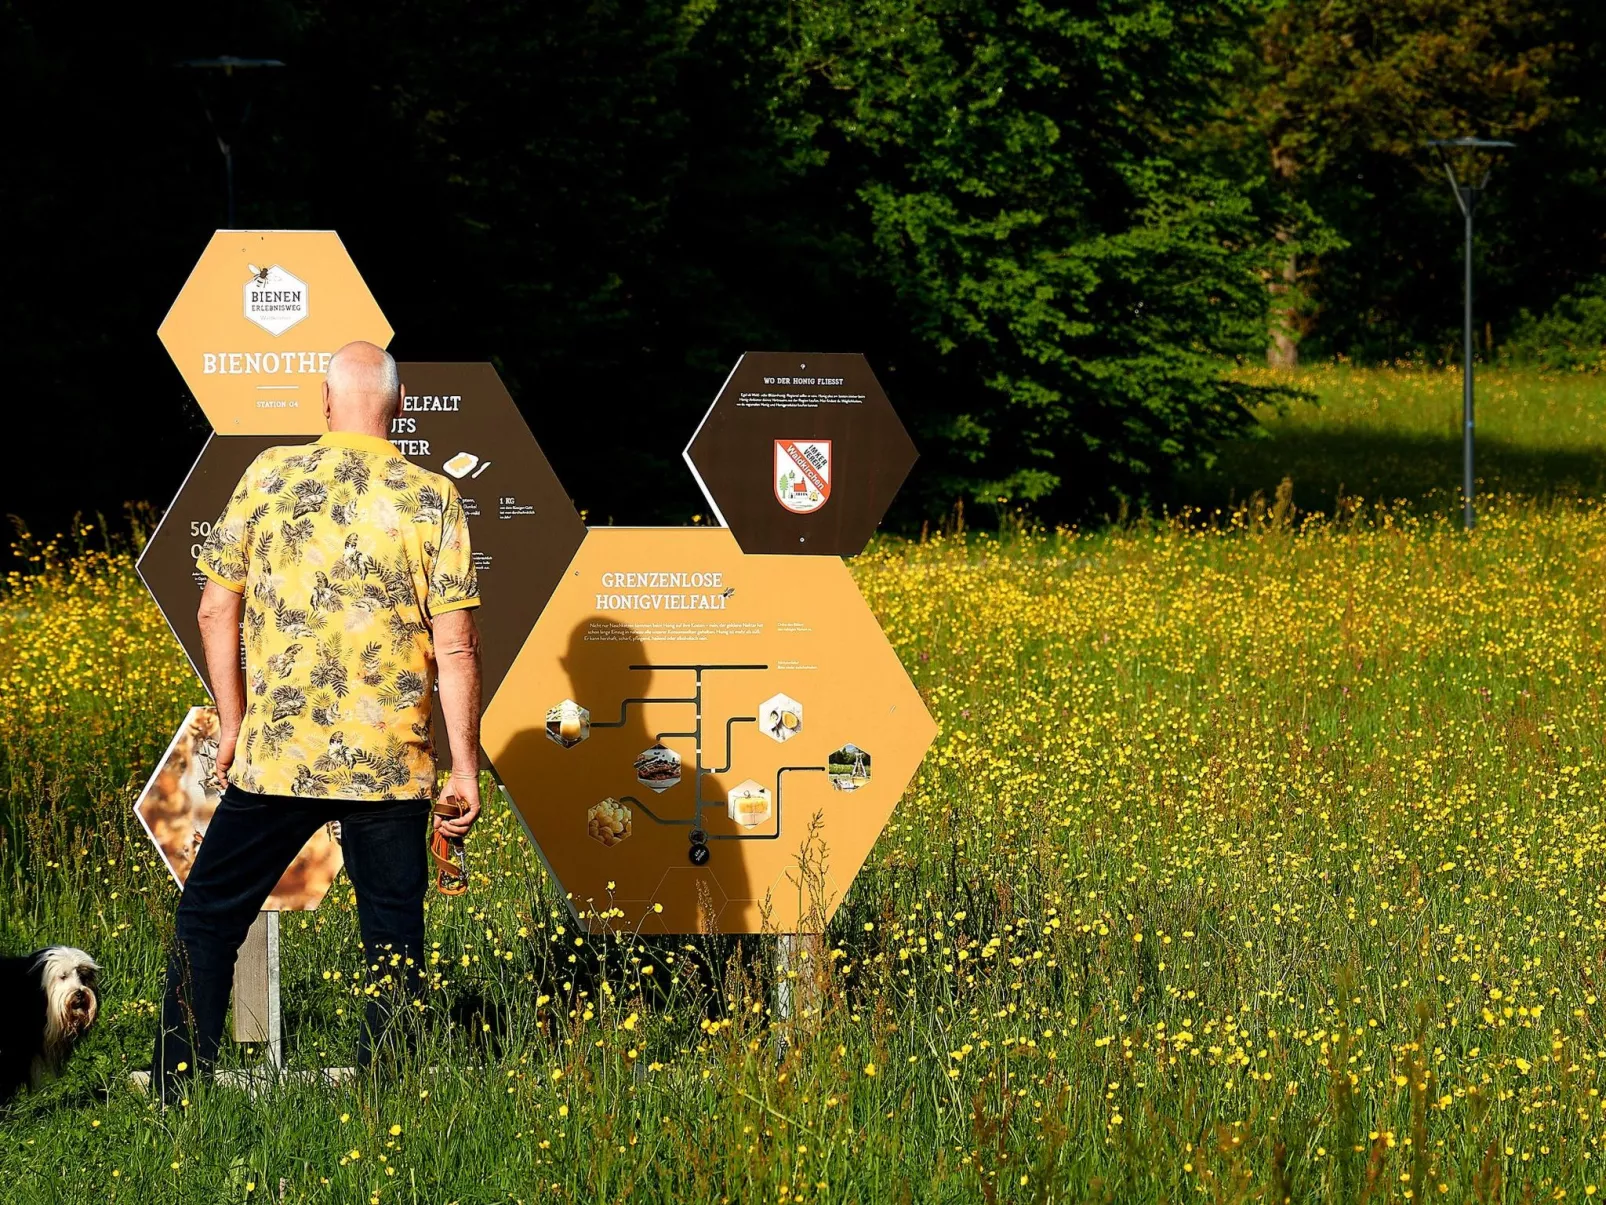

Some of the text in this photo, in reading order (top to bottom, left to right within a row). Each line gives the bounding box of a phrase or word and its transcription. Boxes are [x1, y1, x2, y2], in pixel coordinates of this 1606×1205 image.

[252, 292, 301, 302] BIENEN
[803, 449, 822, 470] VEREIN
[808, 444, 828, 466] IMKER
[787, 445, 824, 490] Waldkirchen
[602, 572, 722, 587] GRENZENLOSE
[596, 595, 726, 610] HONIGVIELFALT
